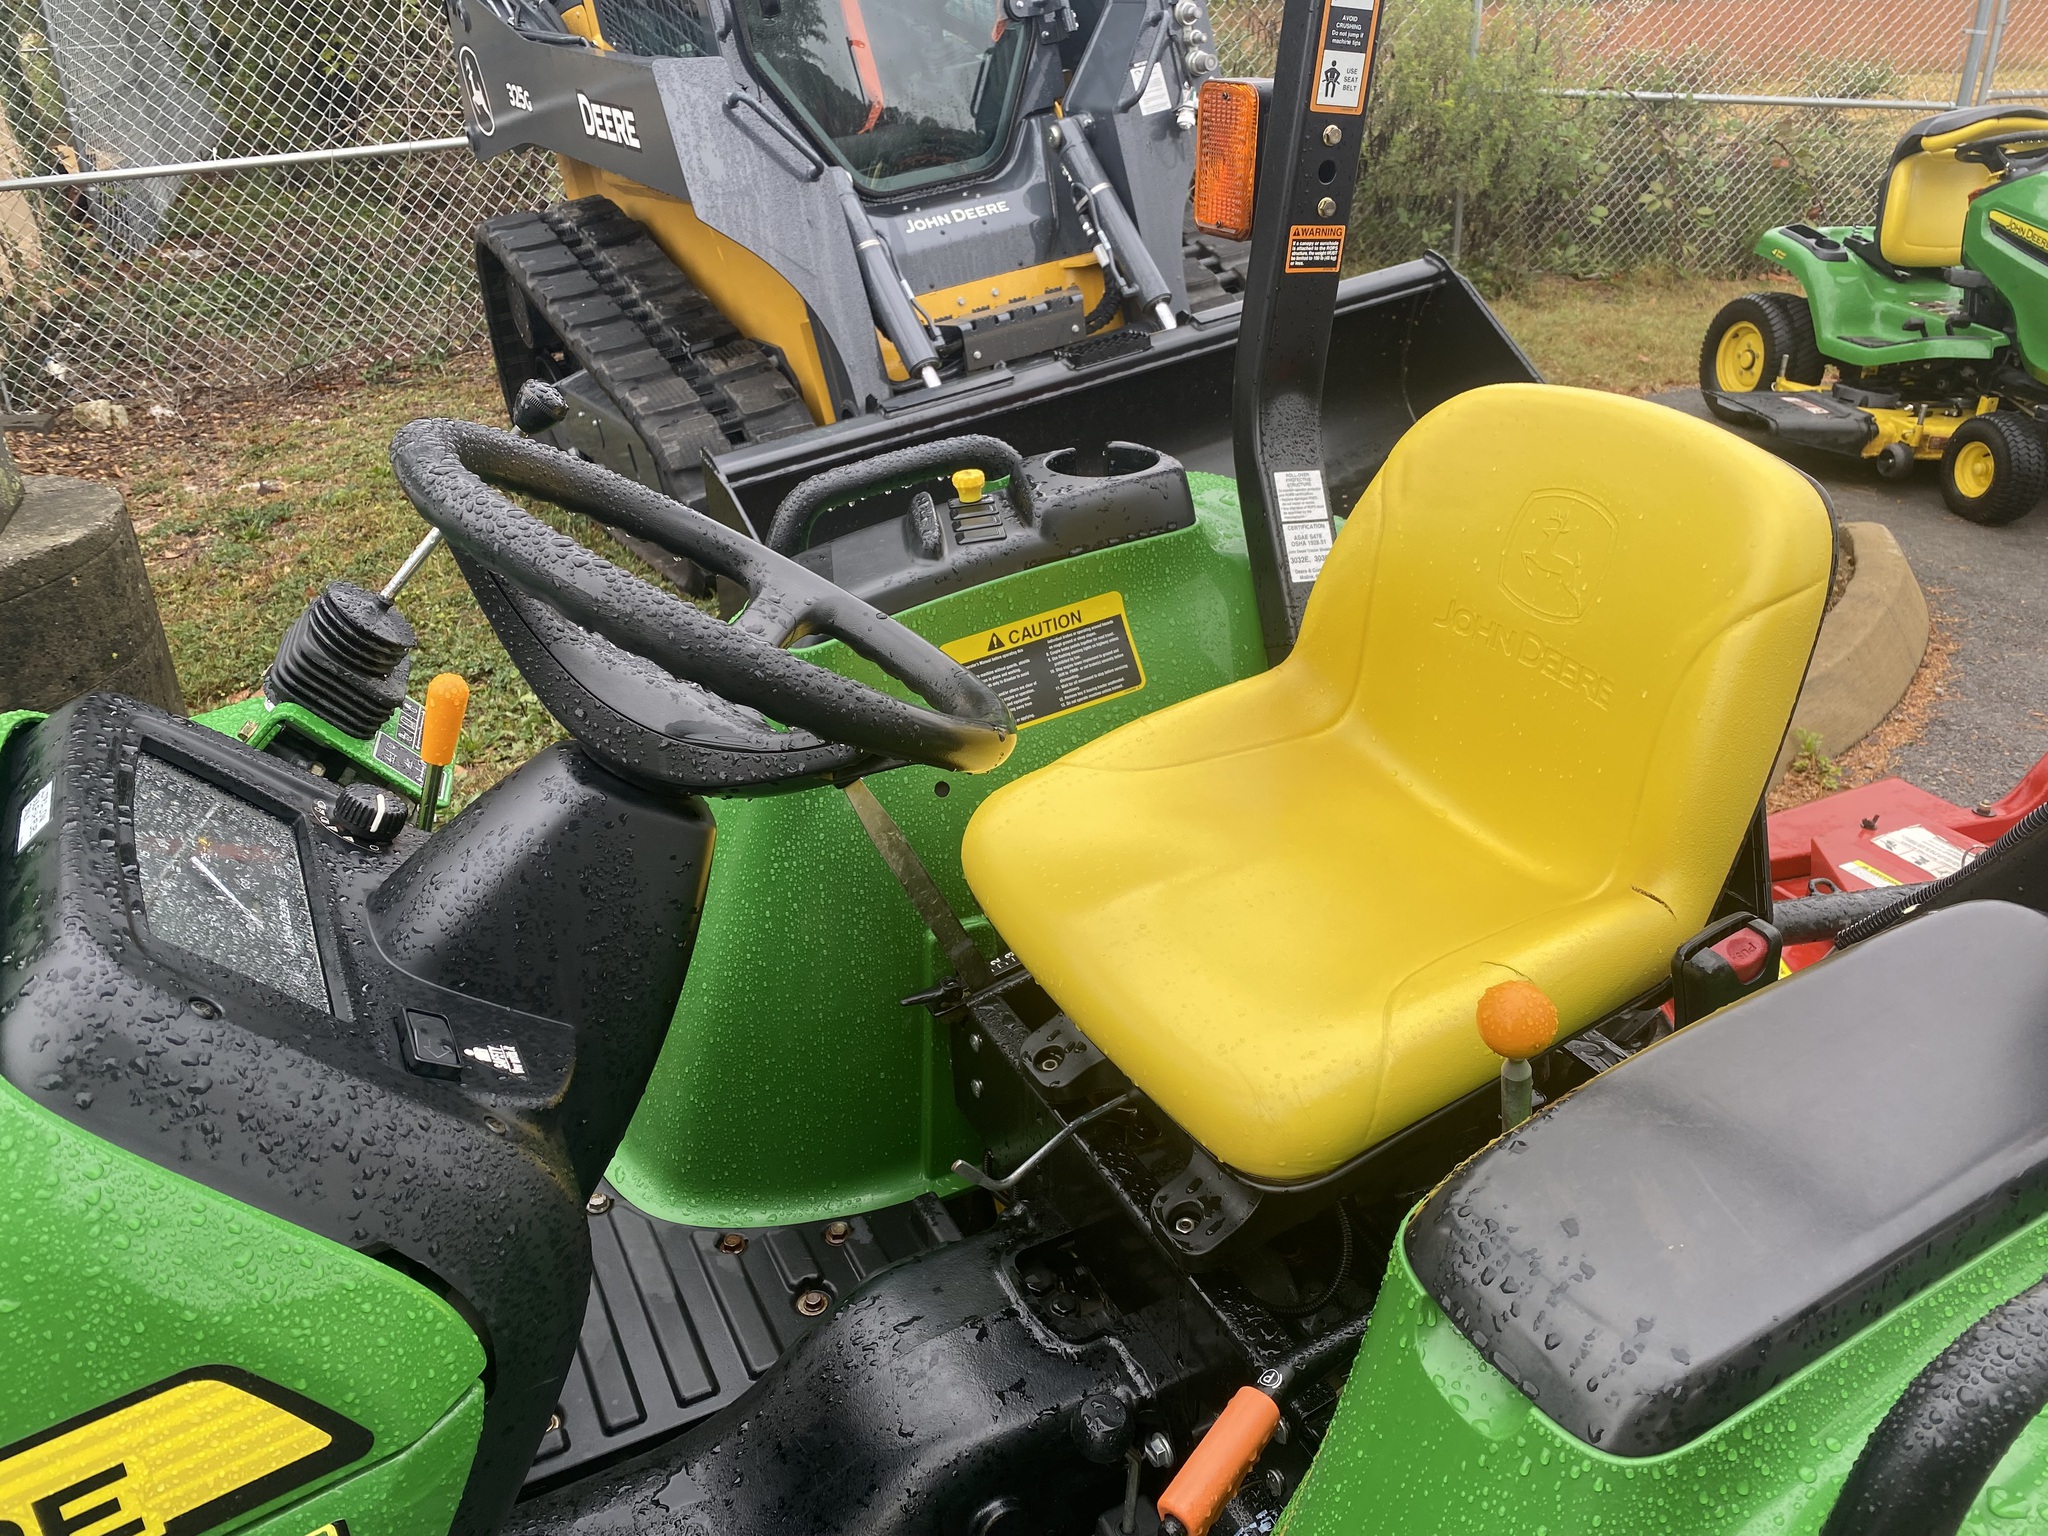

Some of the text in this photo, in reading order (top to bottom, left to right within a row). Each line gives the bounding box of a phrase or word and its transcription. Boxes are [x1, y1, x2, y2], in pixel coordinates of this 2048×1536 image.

[1336, 22, 1362, 30] CRUSHING
[1348, 31, 1359, 39] jump
[505, 83, 533, 112] 325G
[577, 93, 641, 149] DEERE
[906, 201, 1010, 234] JOHN DEERE
[2005, 219, 2027, 236] JOHN
[1301, 228, 1342, 236] WARNING
[1287, 523, 1325, 531] CERTIFICATION
[1008, 609, 1082, 644] CAUTION
[1432, 599, 1615, 711] JOHN DEERE
[1730, 942, 1757, 960] PUSH
[0, 1462, 146, 1536] E
